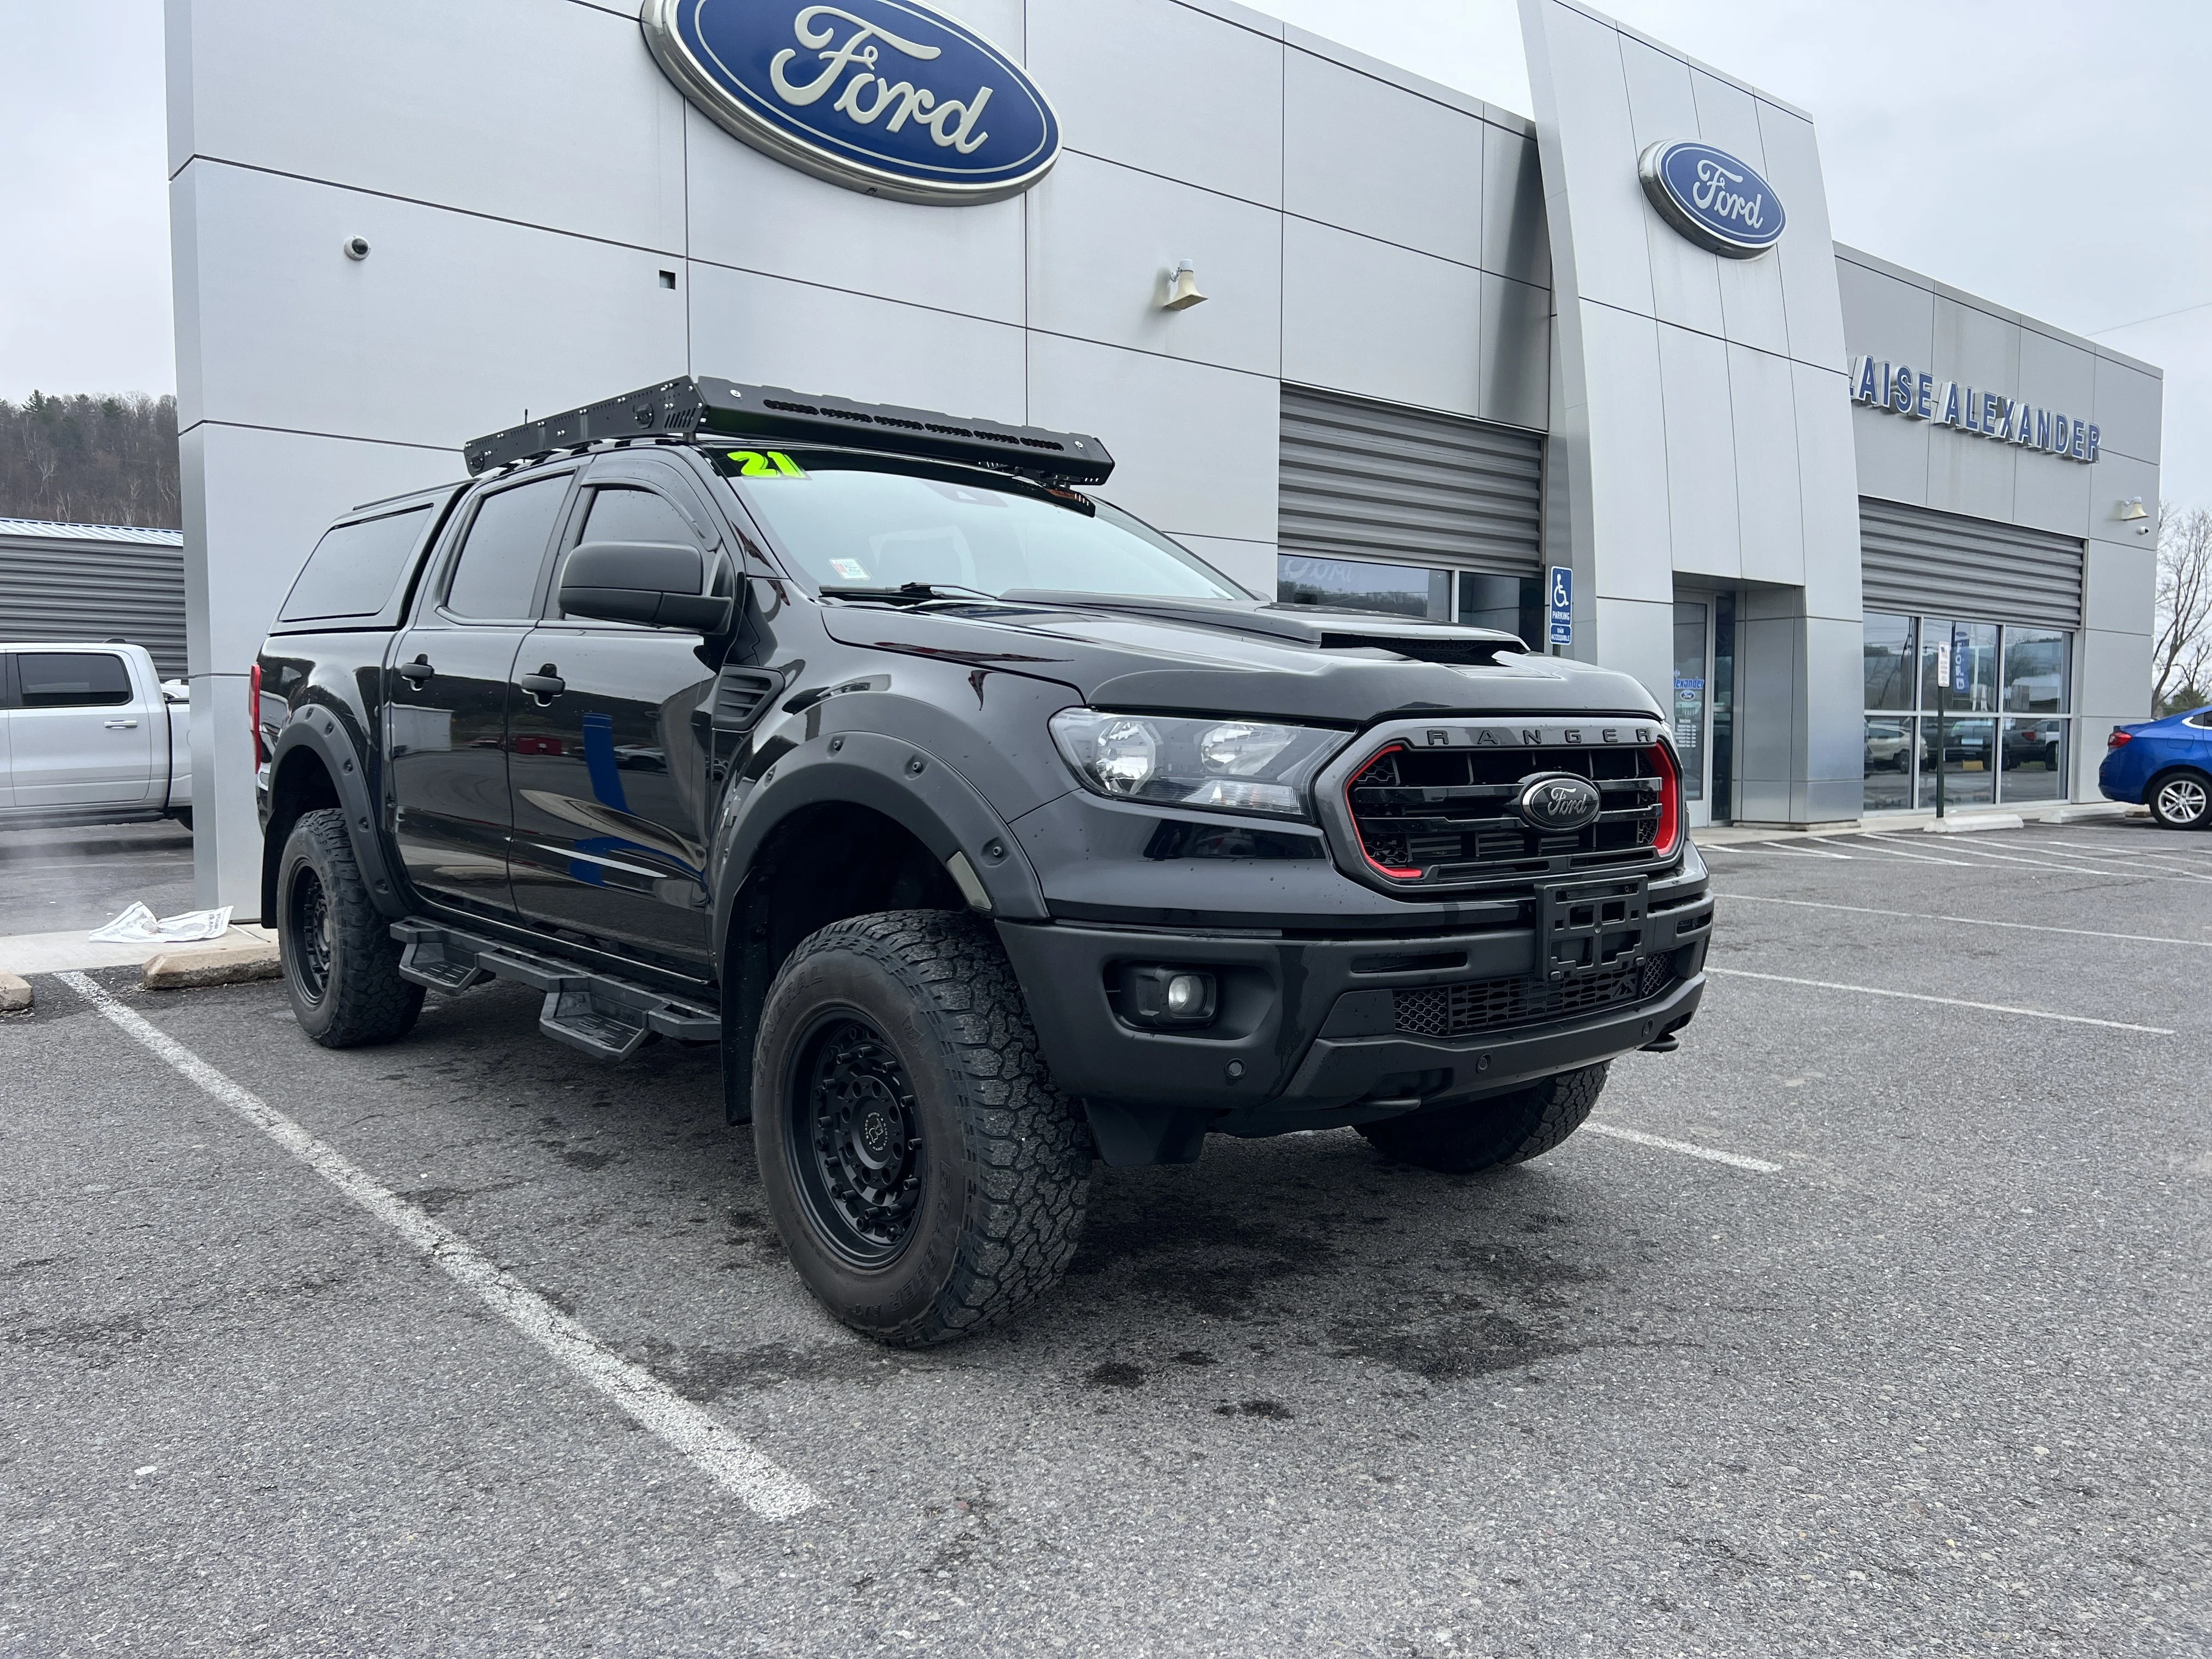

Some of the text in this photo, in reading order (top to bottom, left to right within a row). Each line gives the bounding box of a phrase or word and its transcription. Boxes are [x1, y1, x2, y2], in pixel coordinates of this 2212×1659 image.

[770, 5, 994, 155] Ford
[1692, 159, 1764, 229] Ford
[1849, 354, 2101, 463] AISE ALEXANDER
[727, 451, 806, 478] 21
[1552, 610, 1570, 621] PARKING
[1674, 676, 1704, 690] lexander
[1427, 729, 1651, 746] RANGER
[1547, 787, 1588, 817] Ford
